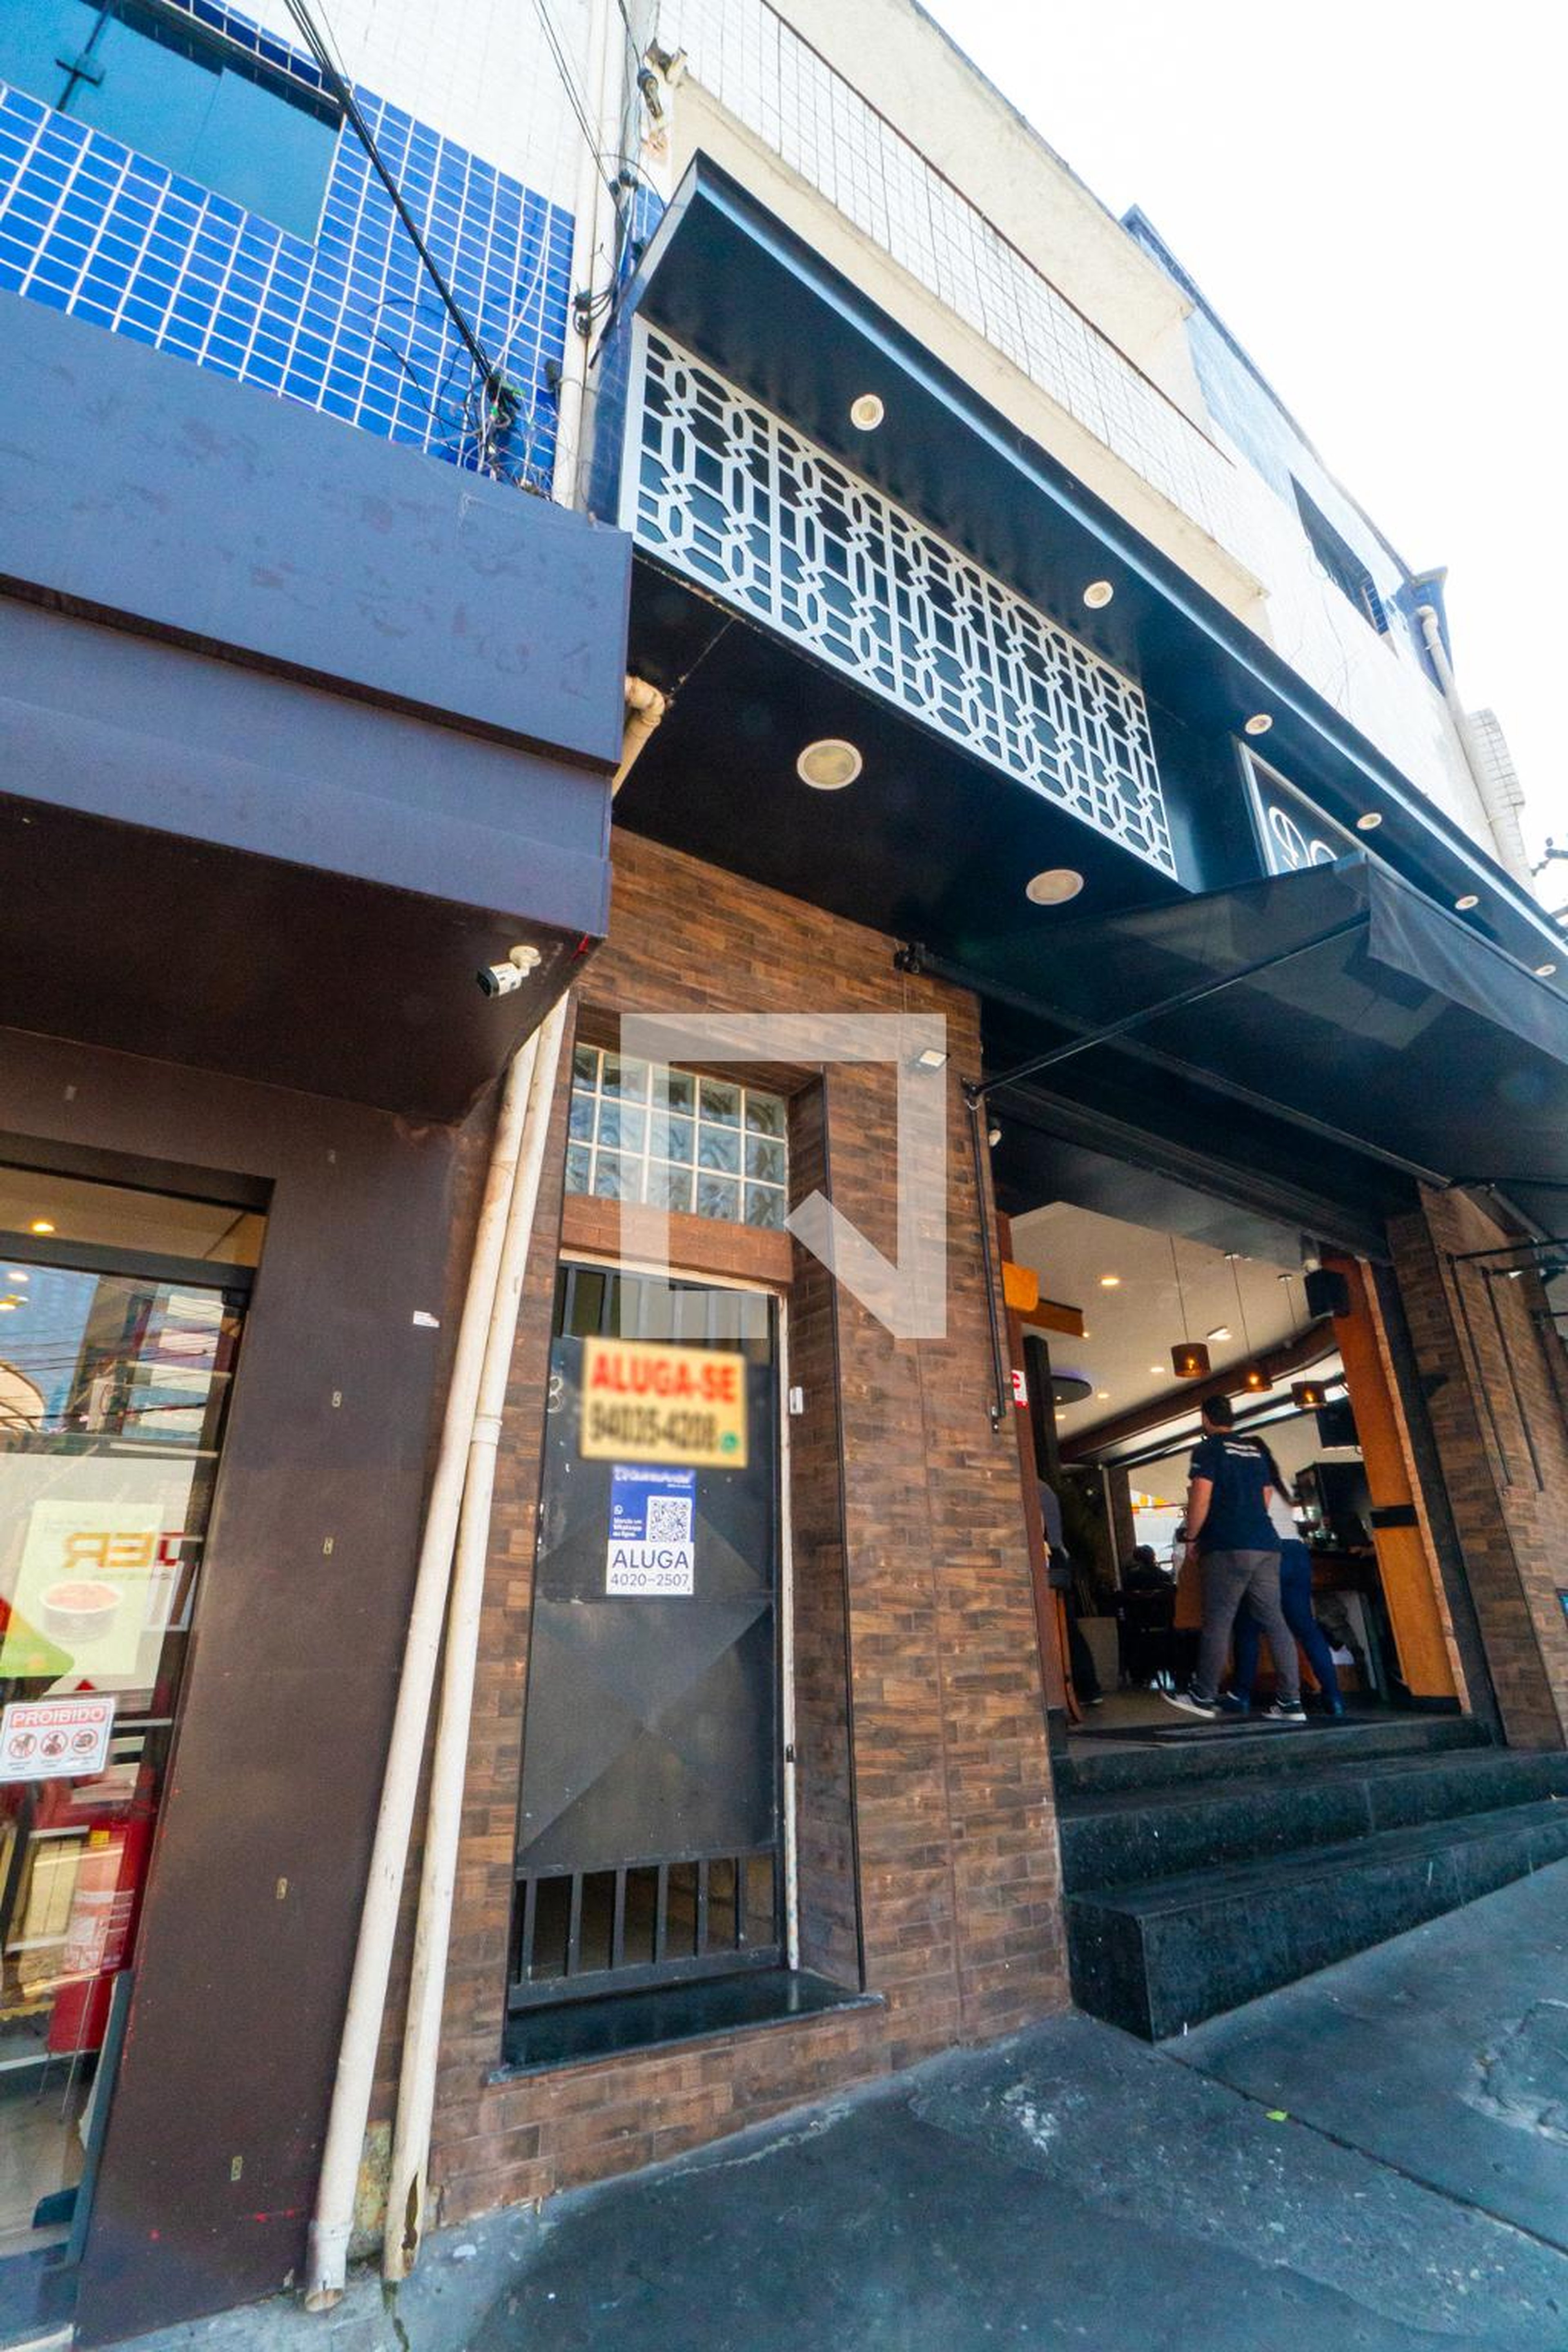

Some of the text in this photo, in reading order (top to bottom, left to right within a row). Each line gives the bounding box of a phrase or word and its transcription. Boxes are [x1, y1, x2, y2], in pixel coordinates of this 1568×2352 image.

[591, 1353, 736, 1404] ALUGA-SE
[612, 1550, 688, 1569] ALUGA
[611, 1573, 688, 1586] 4020-2507
[12, 1707, 105, 1728] PROIBIDO
